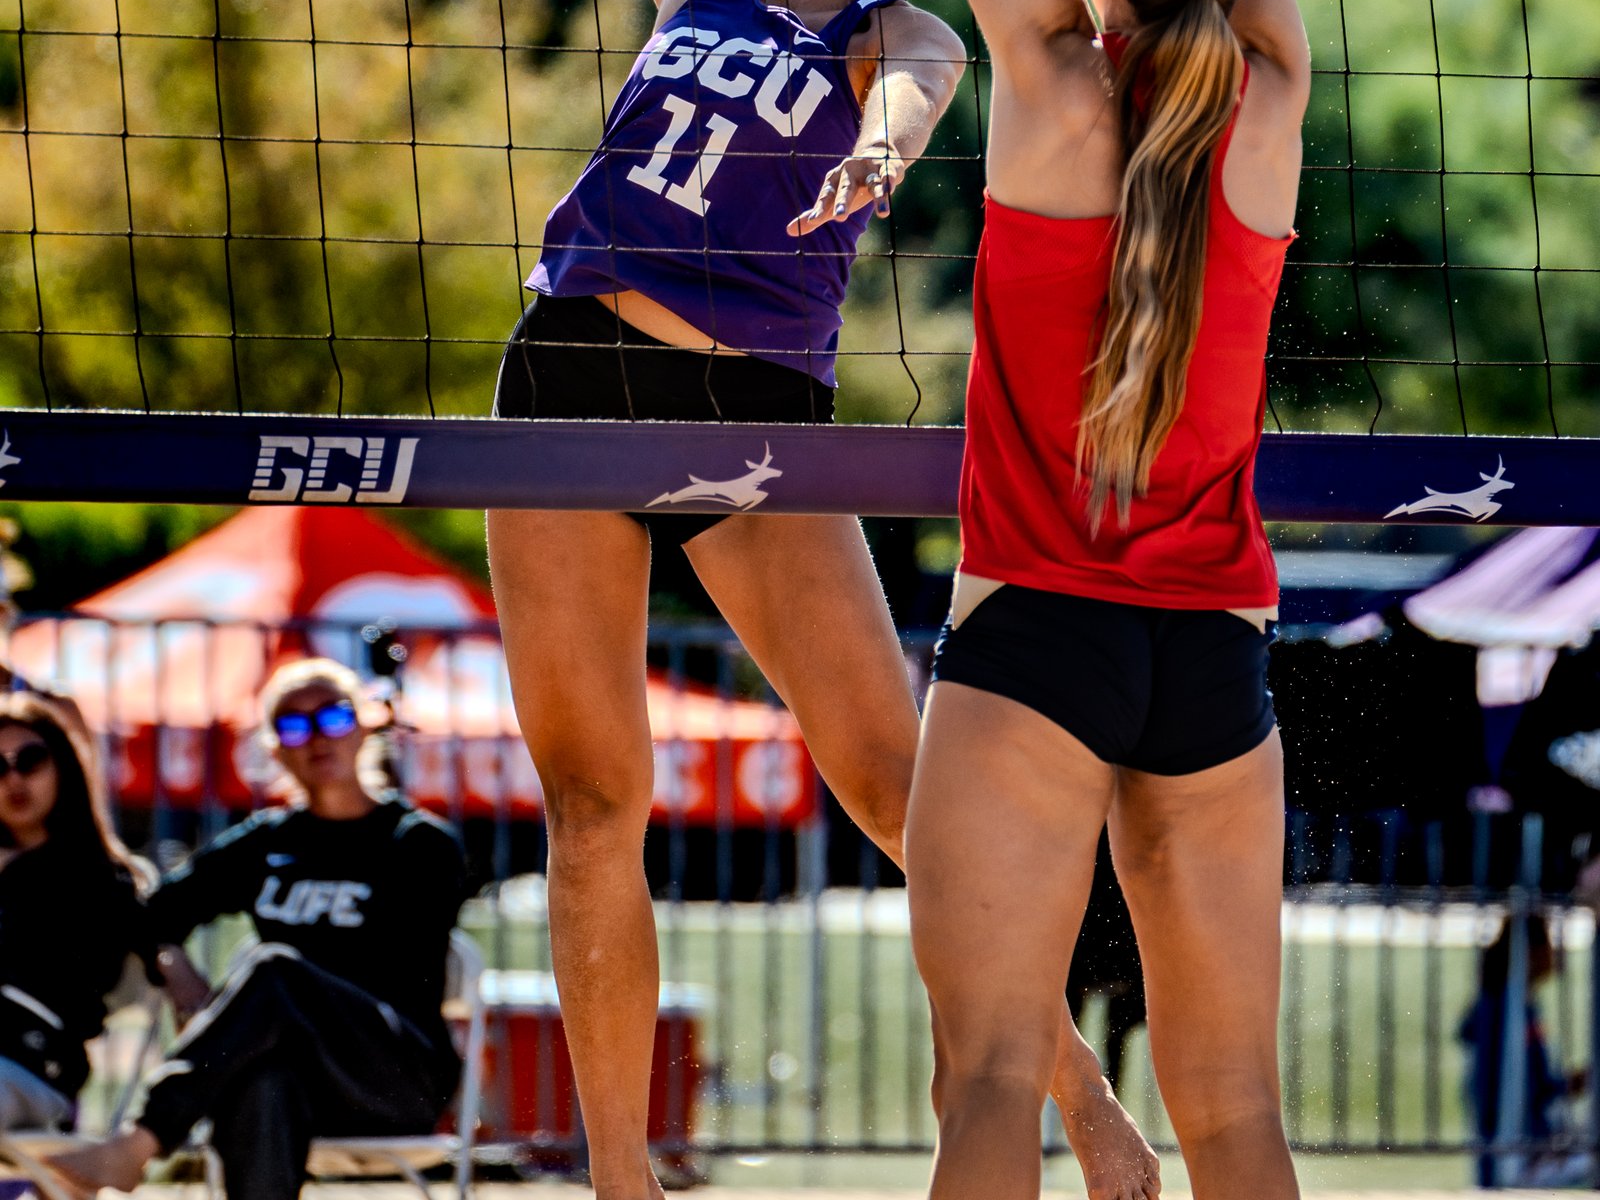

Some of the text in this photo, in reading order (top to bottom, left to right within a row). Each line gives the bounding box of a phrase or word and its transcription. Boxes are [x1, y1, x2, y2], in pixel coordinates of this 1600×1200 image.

[642, 26, 833, 138] GCU
[626, 93, 738, 217] 11
[248, 435, 420, 504] GCU
